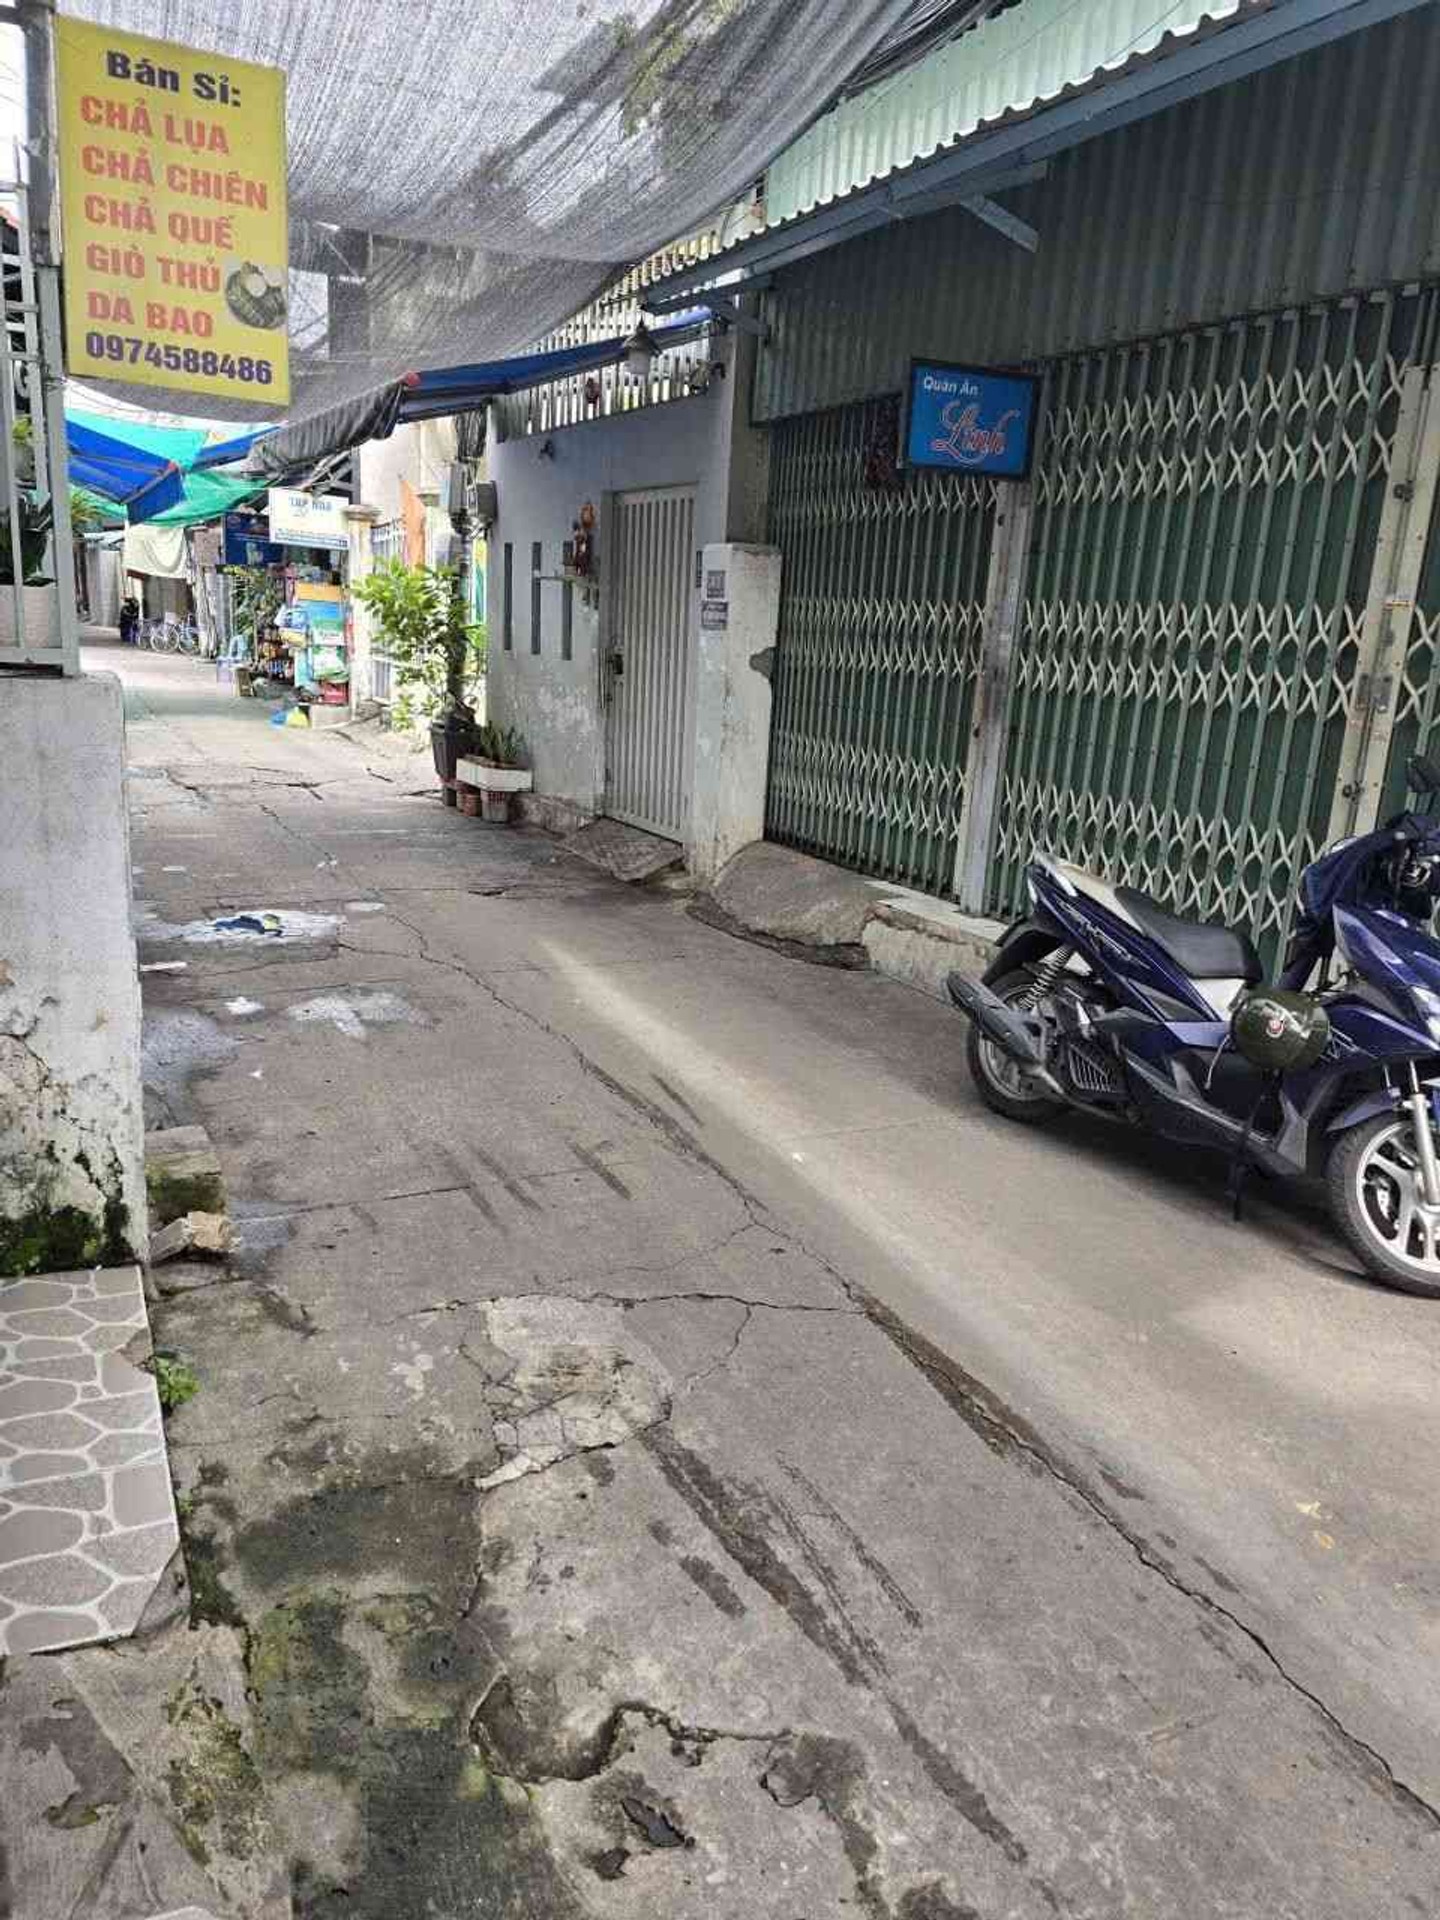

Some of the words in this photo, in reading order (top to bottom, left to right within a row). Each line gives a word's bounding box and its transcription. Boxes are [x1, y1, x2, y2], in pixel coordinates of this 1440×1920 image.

[81, 95, 153, 138] CHẢ
[81, 145, 155, 188] CHẢ
[166, 163, 268, 211] CHIÊN
[84, 194, 156, 235] CHẢ
[86, 290, 134, 325] DA
[146, 301, 213, 338] BAO
[86, 331, 272, 385] 0974588486
